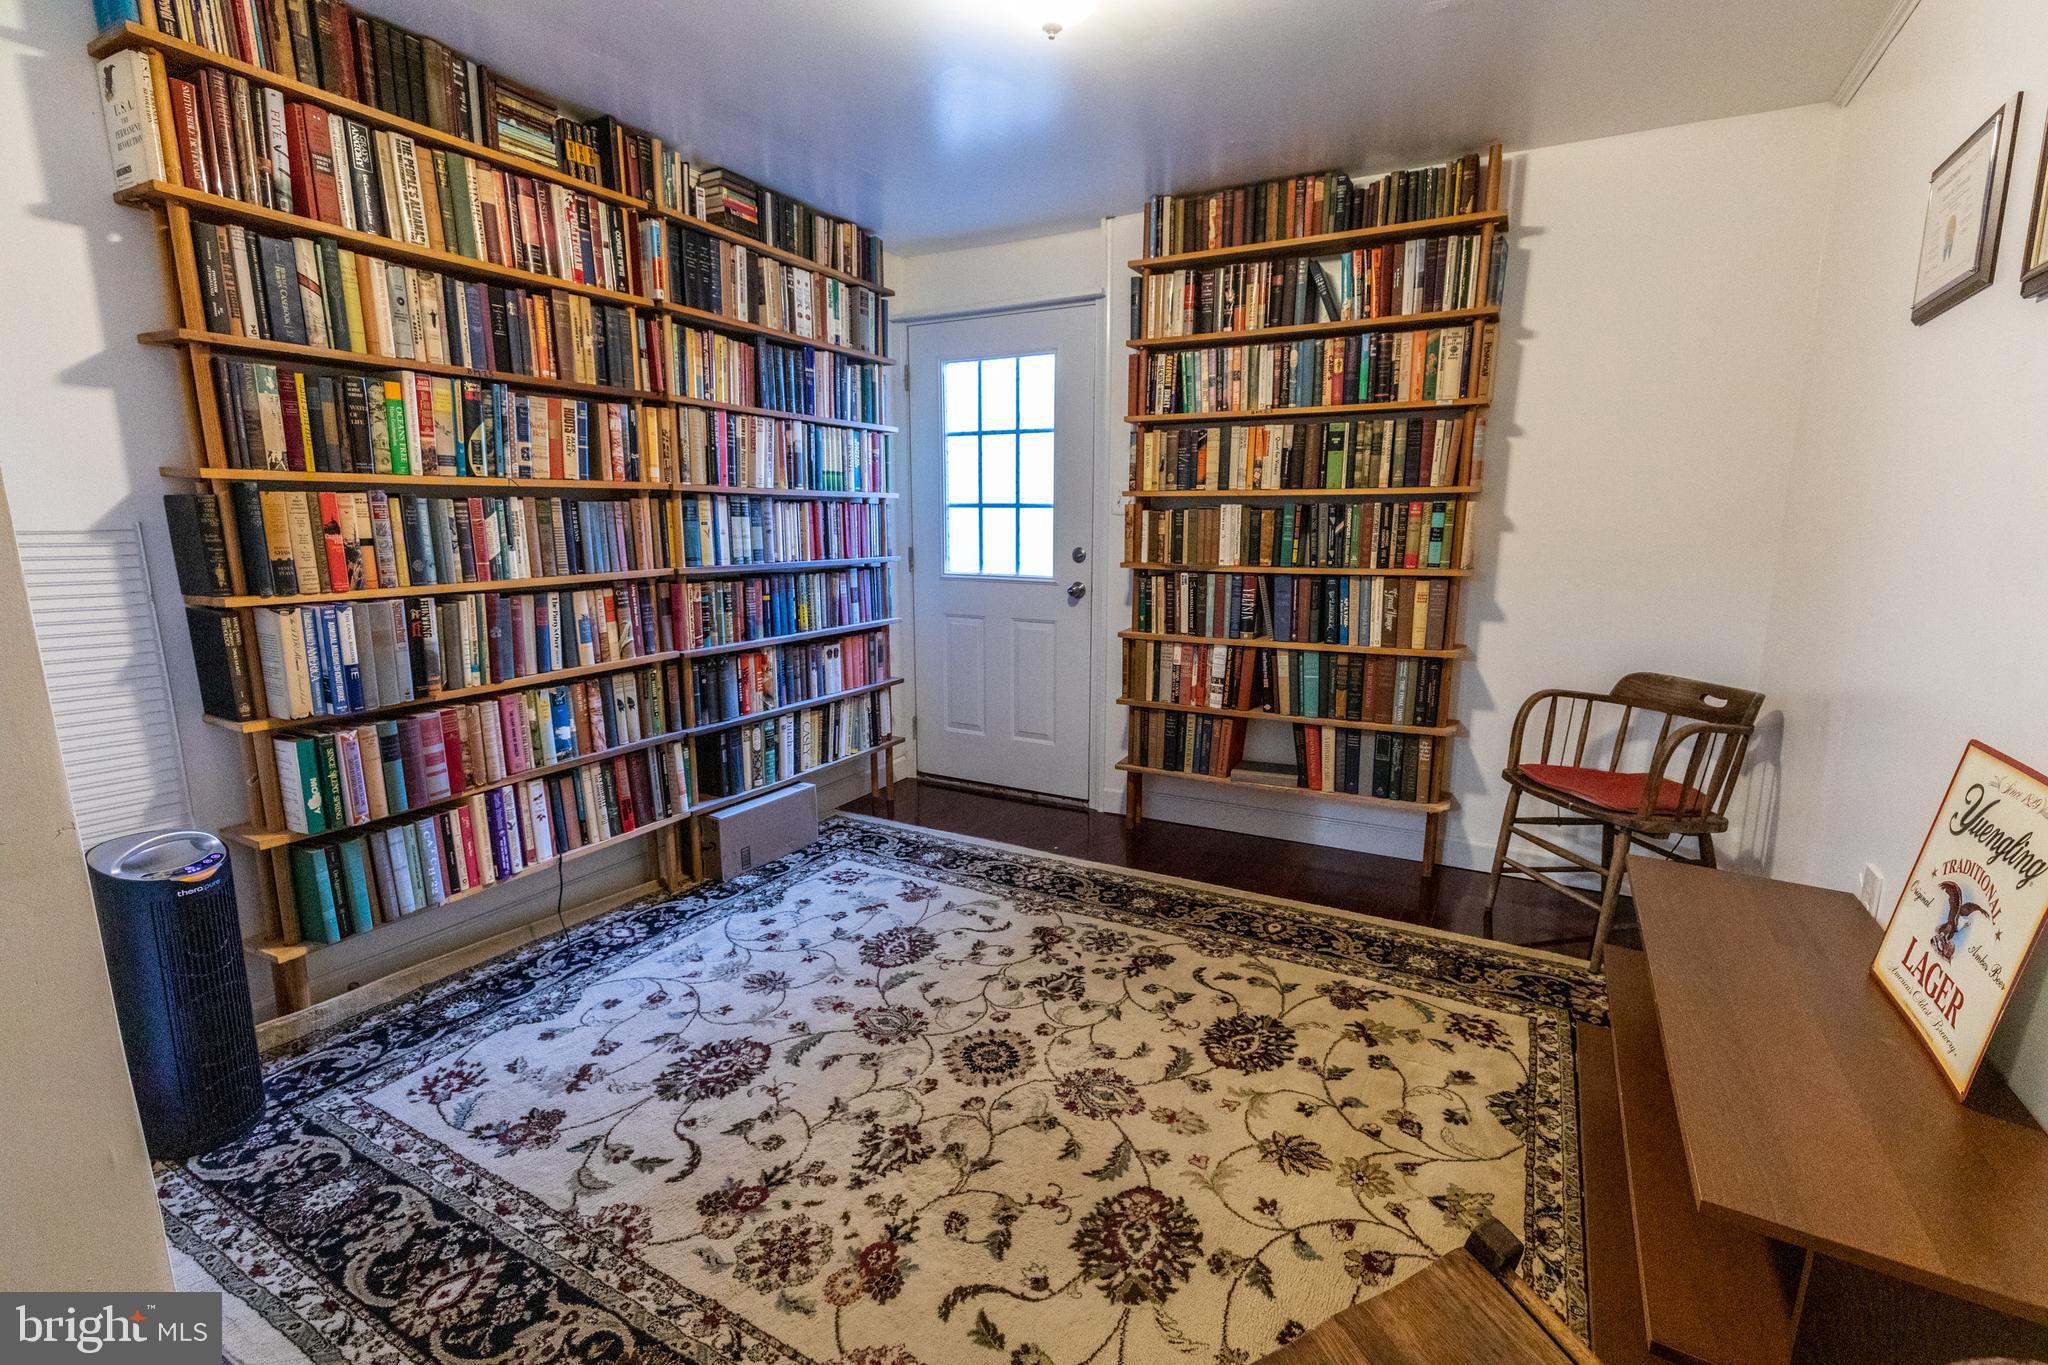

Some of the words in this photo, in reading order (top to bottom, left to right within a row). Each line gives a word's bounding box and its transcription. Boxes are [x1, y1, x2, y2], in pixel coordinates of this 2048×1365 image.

[271, 109, 282, 140] FIVE
[351, 126, 364, 167] ANATOMY
[401, 140, 414, 158] THE
[404, 160, 419, 197] PEOPLE'S
[409, 199, 425, 242] ALMANAC
[539, 189, 549, 224] TOLSTOY
[569, 211, 583, 271] POLITICIAN
[615, 230, 623, 258] COMBAT
[280, 289, 290, 324] CASEBOOK
[1482, 342, 1492, 376] PEMMICAN
[396, 406, 405, 441] OCEANS
[564, 408, 576, 433] ROOTS
[400, 443, 408, 463] FREE
[420, 600, 432, 638] HUNTING
[1241, 588, 1256, 620] YELTSIN
[328, 622, 338, 644] ADMIRAL
[307, 645, 320, 682] AMERICA
[786, 716, 794, 747] Dutch
[1186, 722, 1194, 768] VIKINGERNE
[326, 748, 335, 770] SINCE
[309, 777, 321, 814] MOY
[328, 771, 338, 794] SILENT
[333, 796, 342, 820] SPRING
[1949, 783, 2048, 890] Yuengling
[177, 879, 222, 898] therapure
[1910, 879, 1935, 908] Original
[1942, 858, 2002, 925] TRADITIONAL
[1901, 936, 1965, 1030] LAGER
[1967, 945, 1989, 972] Amber
[1988, 963, 2006, 991] Beer
[1912, 990, 1933, 1017] Oldest
